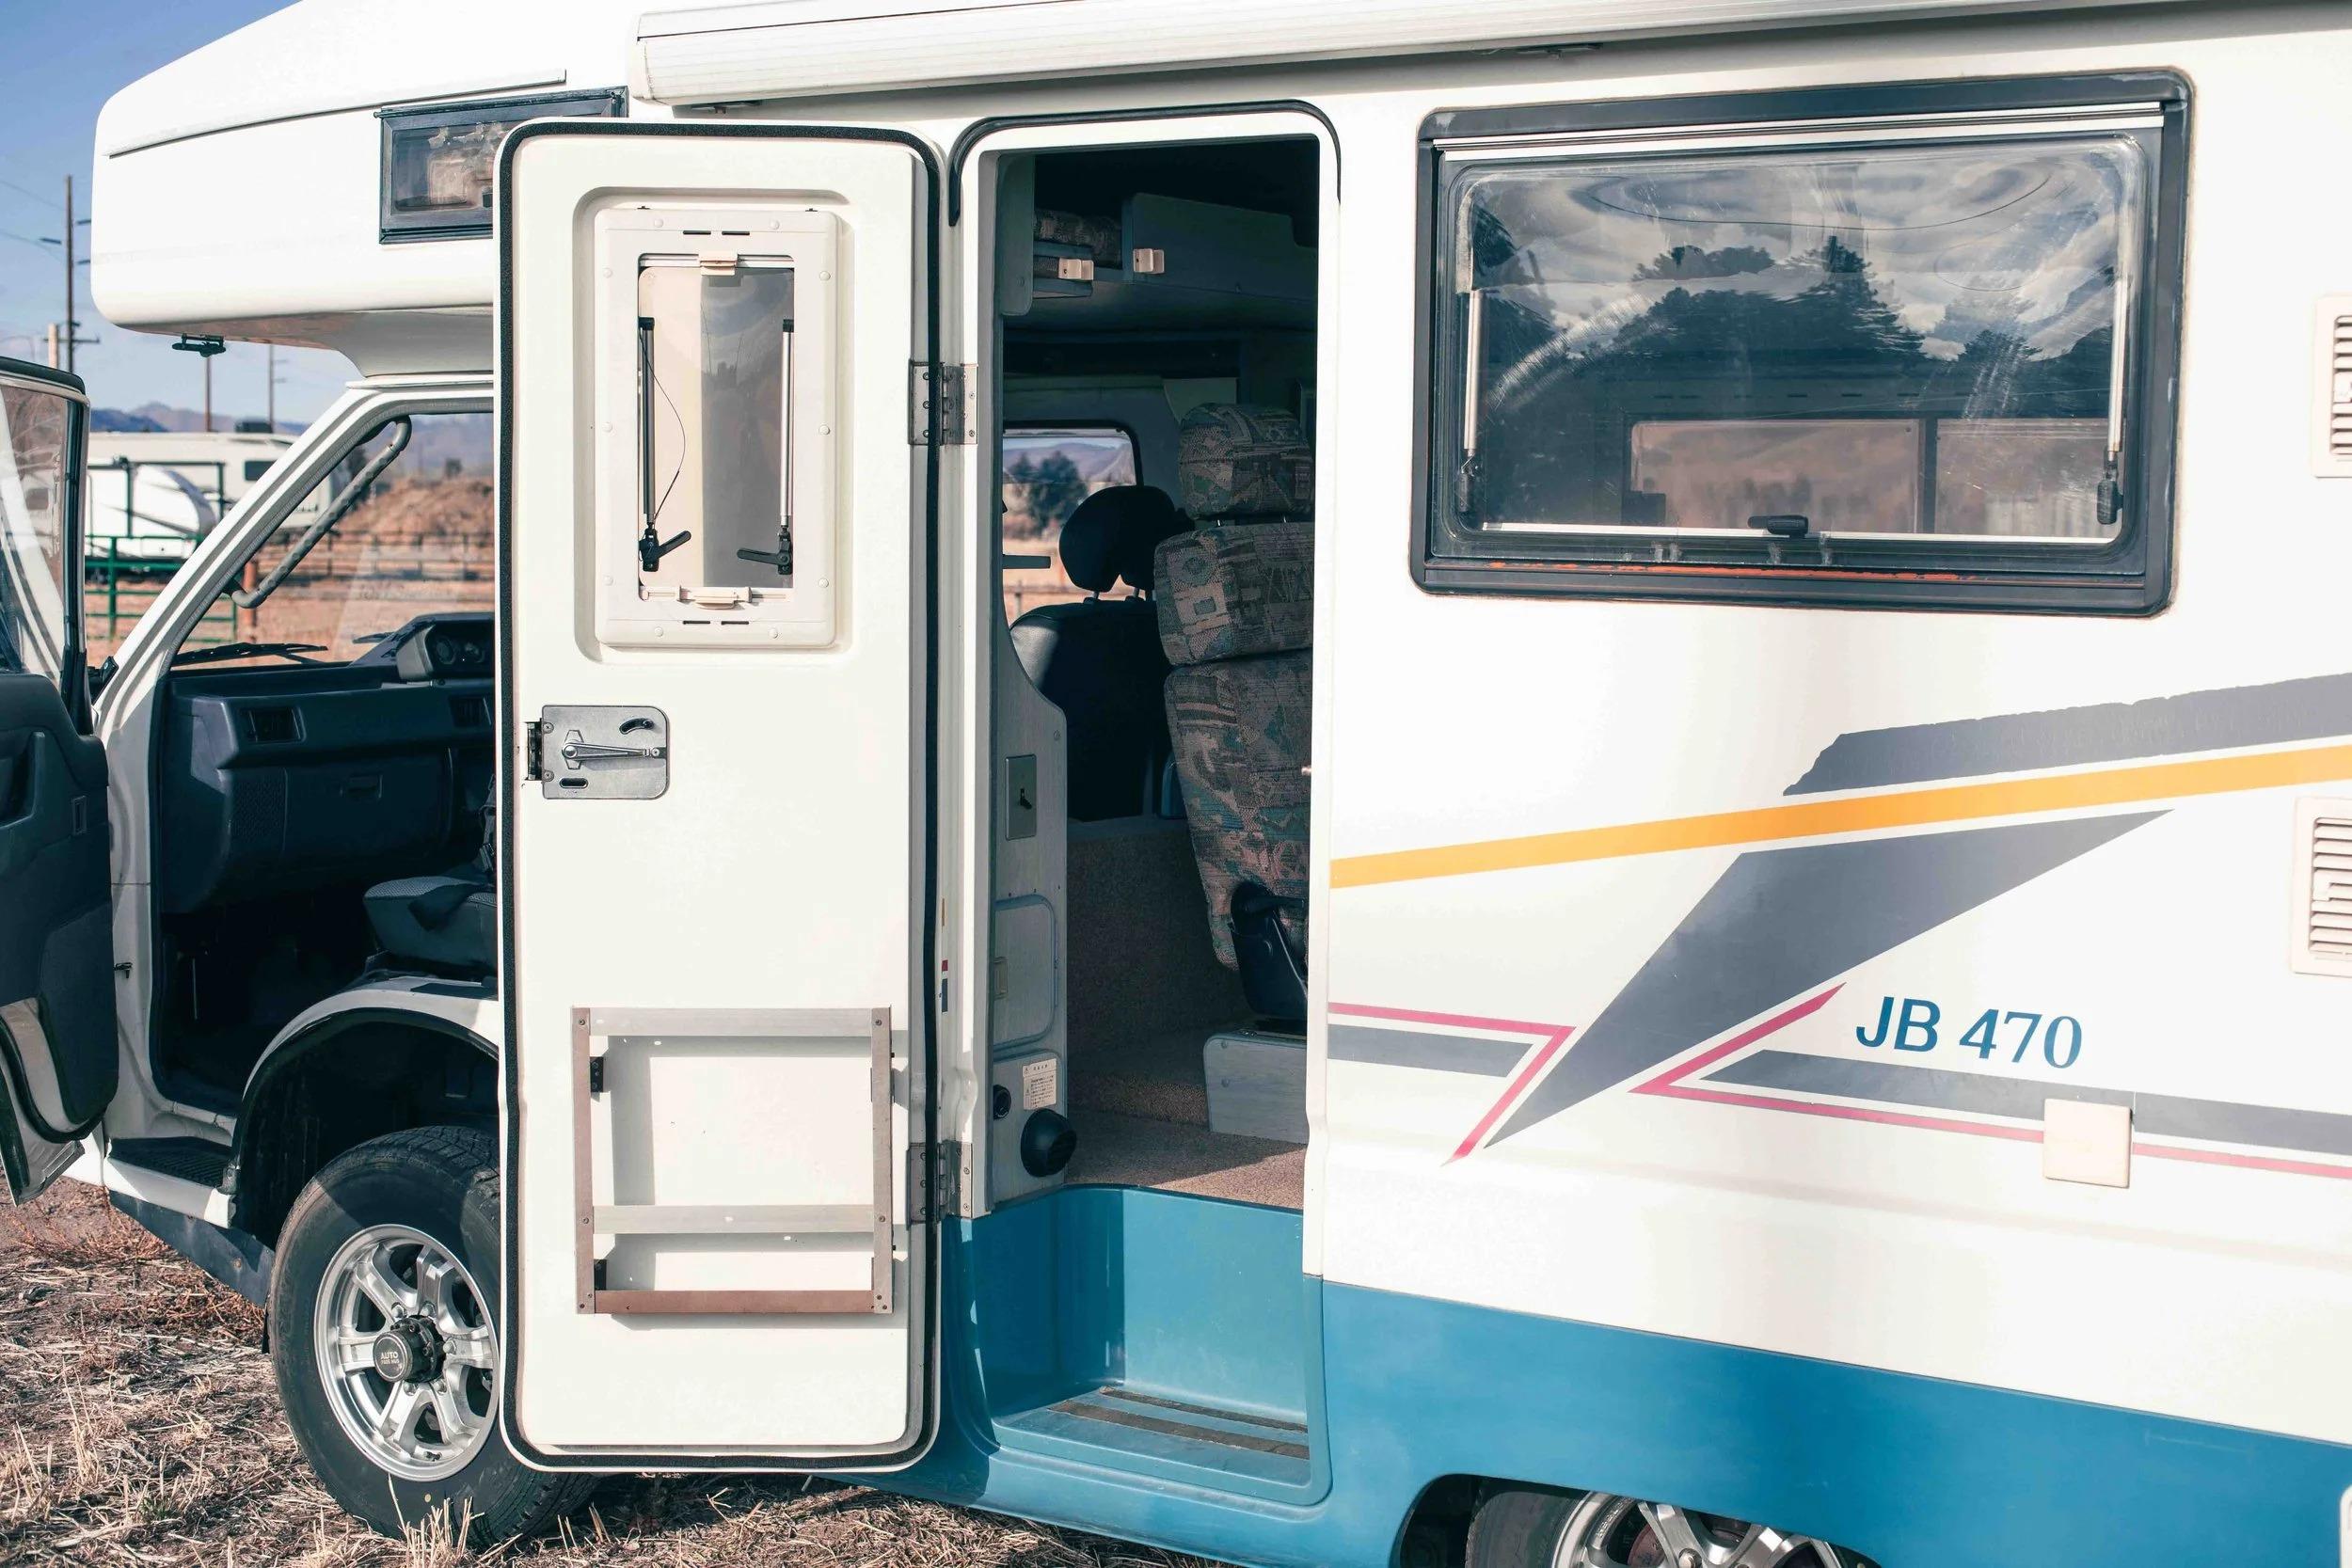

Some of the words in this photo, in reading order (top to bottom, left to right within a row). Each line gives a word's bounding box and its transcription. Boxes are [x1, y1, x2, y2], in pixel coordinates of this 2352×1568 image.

[1855, 996, 1941, 1053] JB
[1959, 1008, 2083, 1069] 470
[380, 1351, 399, 1360] AUTO
